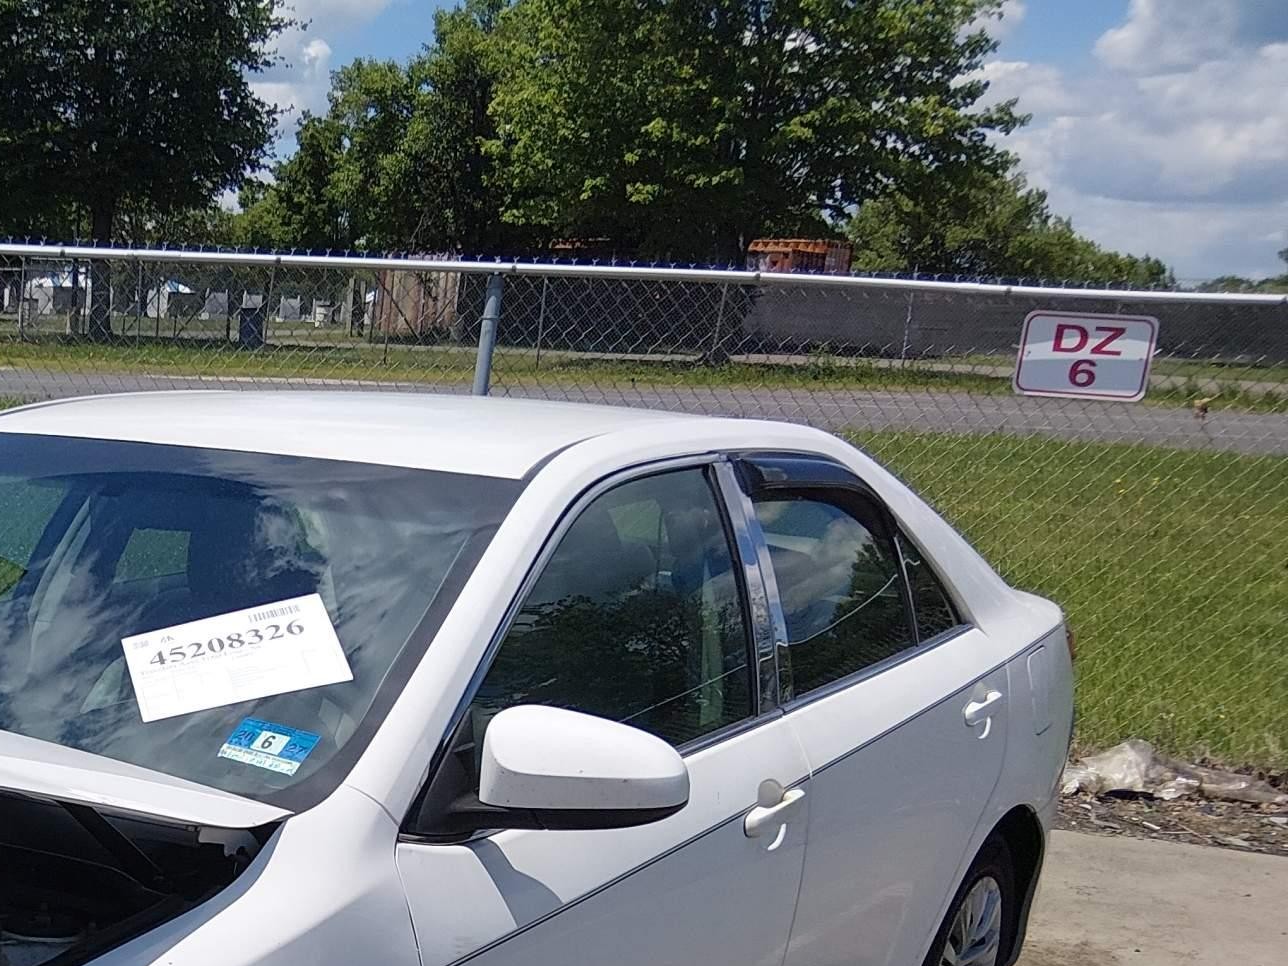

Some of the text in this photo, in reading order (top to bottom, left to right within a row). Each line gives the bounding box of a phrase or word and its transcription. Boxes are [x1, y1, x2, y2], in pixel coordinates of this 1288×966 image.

[1052, 323, 1128, 356] DZ
[1068, 359, 1097, 387] 6
[149, 619, 305, 666] 45208326
[261, 735, 276, 750] 6
